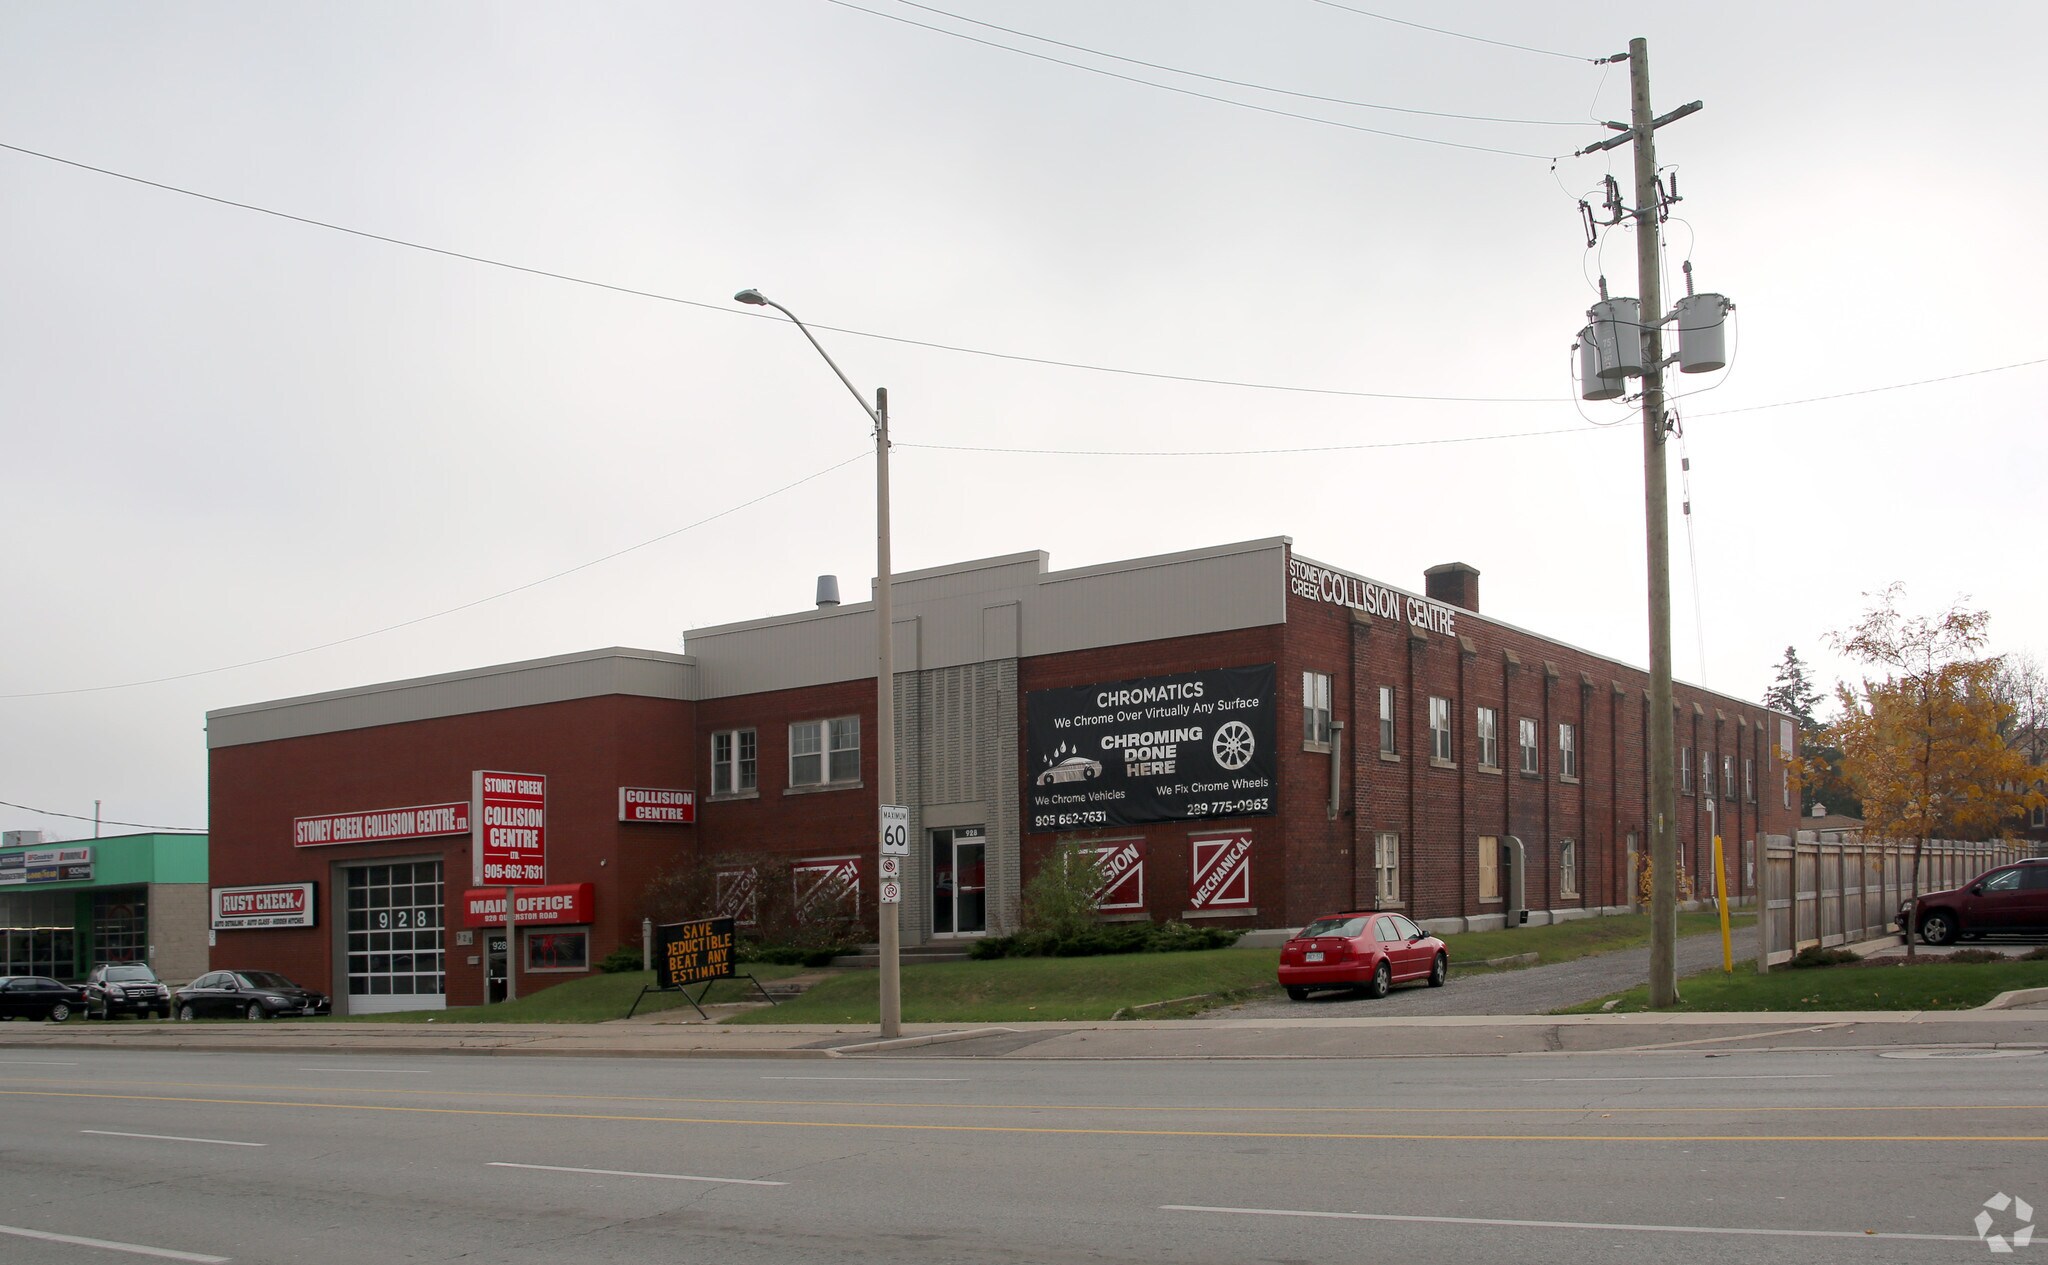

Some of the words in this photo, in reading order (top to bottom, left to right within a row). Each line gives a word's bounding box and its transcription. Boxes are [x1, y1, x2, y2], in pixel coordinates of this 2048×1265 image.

[1289, 559, 1322, 585] STONEY
[1291, 577, 1320, 602] CREEK
[1320, 569, 1400, 622] COLLISION
[1406, 596, 1456, 637] CENTRE
[1096, 681, 1204, 708] CHROMATICS
[1054, 718, 1071, 729] We
[1073, 710, 1114, 727] Chrome
[1116, 709, 1143, 721] Over
[1144, 703, 1190, 719] Virtually
[1193, 702, 1215, 714] Any
[1217, 697, 1260, 711] Surface
[1100, 726, 1203, 750] CHROMING
[1124, 744, 1177, 763] DONE
[1126, 761, 1176, 778] HERE
[484, 777, 517, 793] STONEY
[517, 780, 543, 795] CREEK
[1156, 785, 1173, 796] We
[1174, 784, 1189, 794] Fix
[1191, 782, 1230, 793] Chrome
[1231, 777, 1269, 789] Wheels
[626, 790, 693, 805] COLLISION
[1035, 796, 1050, 806] We
[1051, 793, 1086, 804] Chrome
[1088, 789, 1126, 802] Vehicles
[1187, 803, 1208, 816] 289
[1211, 797, 1269, 814] 775-0963
[484, 805, 543, 827] COLLISION
[635, 806, 684, 820] CENTRE
[883, 811, 906, 819] MAXIMUM
[1035, 814, 1056, 827] 905
[1058, 810, 1107, 825] 662-7631
[297, 819, 332, 843] STONEY
[333, 816, 363, 841] CREEK
[364, 811, 415, 838] COLLISION
[417, 807, 455, 833] CENTRE
[489, 827, 539, 848] CENTRE
[884, 825, 906, 846] 60
[484, 863, 543, 879] 905-662-7631
[1190, 837, 1252, 909] MECHANICAL
[223, 894, 254, 911] RUST
[256, 893, 294, 910] CHECK
[516, 896, 573, 911] OFFICE
[683, 922, 713, 939] SAVE
[492, 941, 507, 950] 928
[669, 953, 698, 971] BEAT
[708, 949, 728, 964] ANY
[671, 962, 729, 983] ESTIMATE
